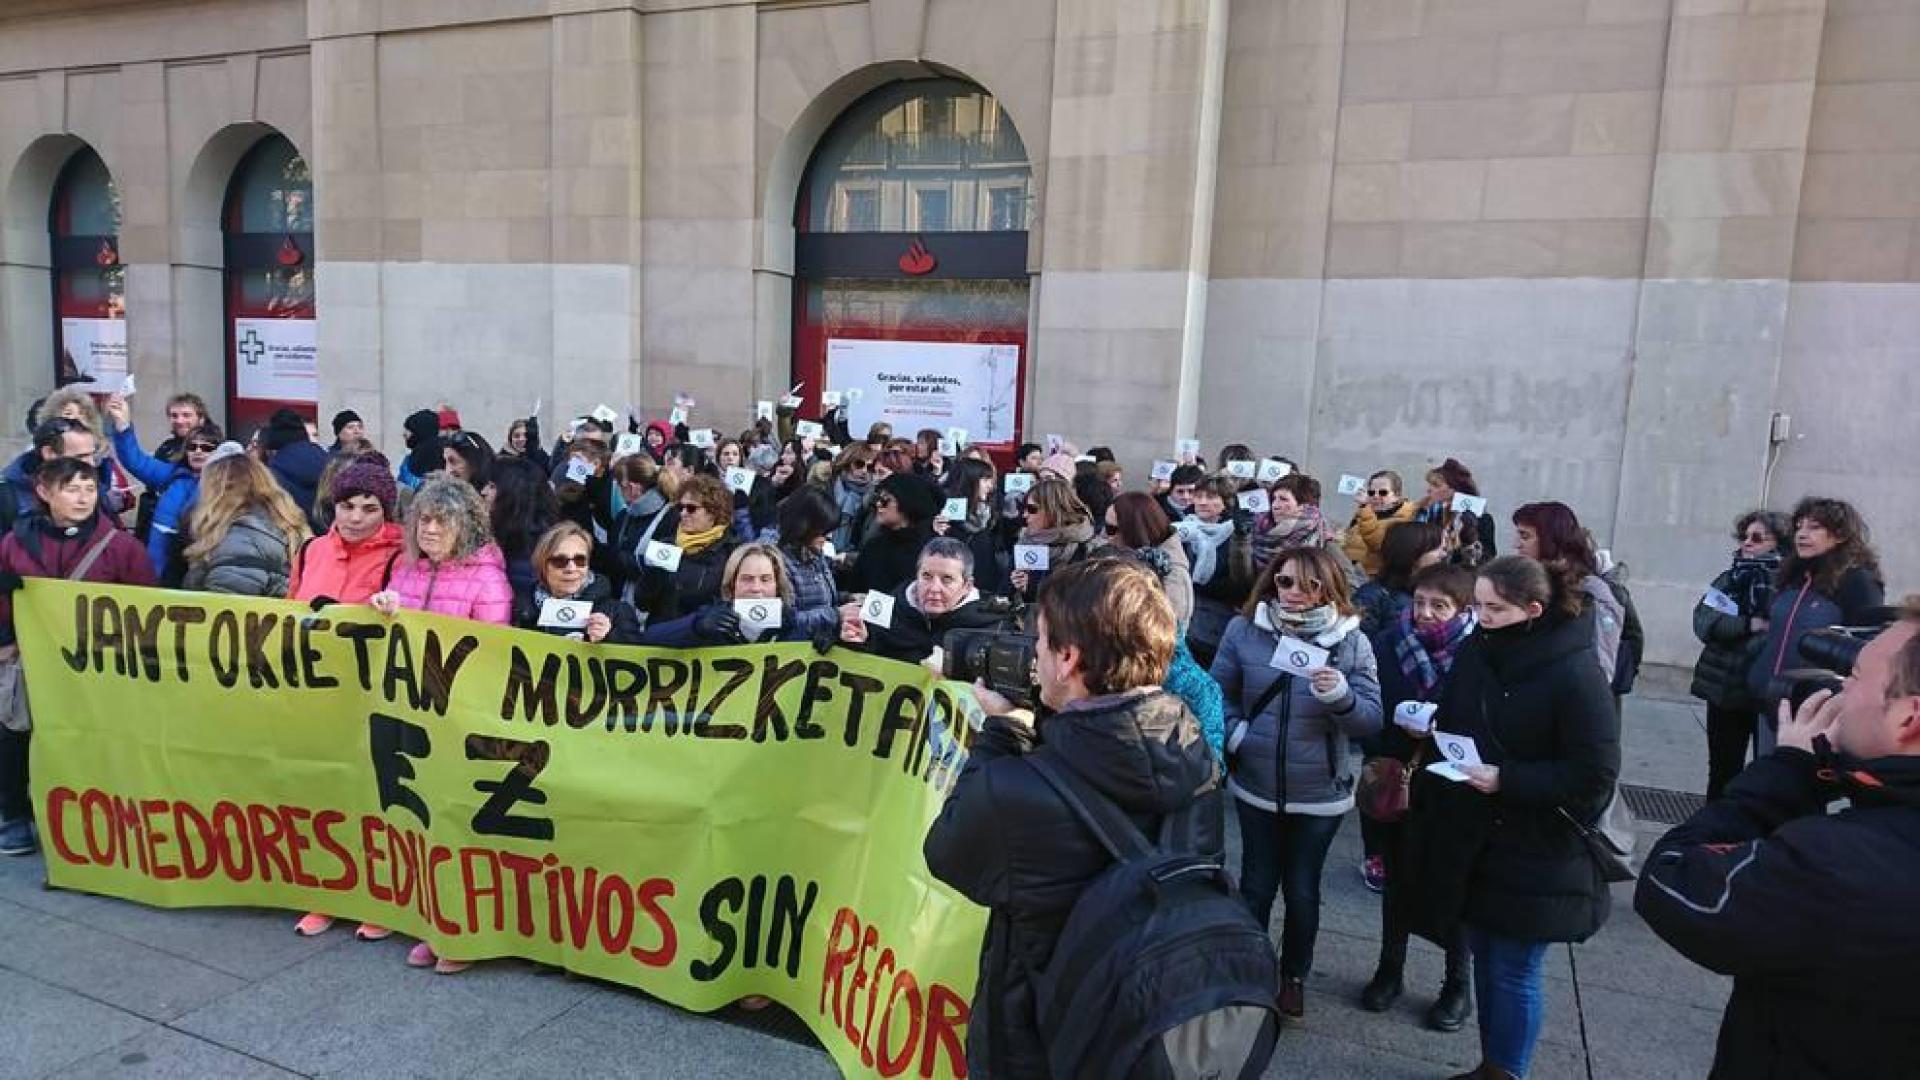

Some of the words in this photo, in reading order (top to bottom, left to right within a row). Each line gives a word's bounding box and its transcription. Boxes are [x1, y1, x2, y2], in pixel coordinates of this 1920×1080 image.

[877, 372, 914, 383] Gracias,
[888, 384, 905, 393] por
[906, 384, 930, 393] estar
[48, 787, 358, 890] COMEDORES
[690, 874, 818, 982] SIN
